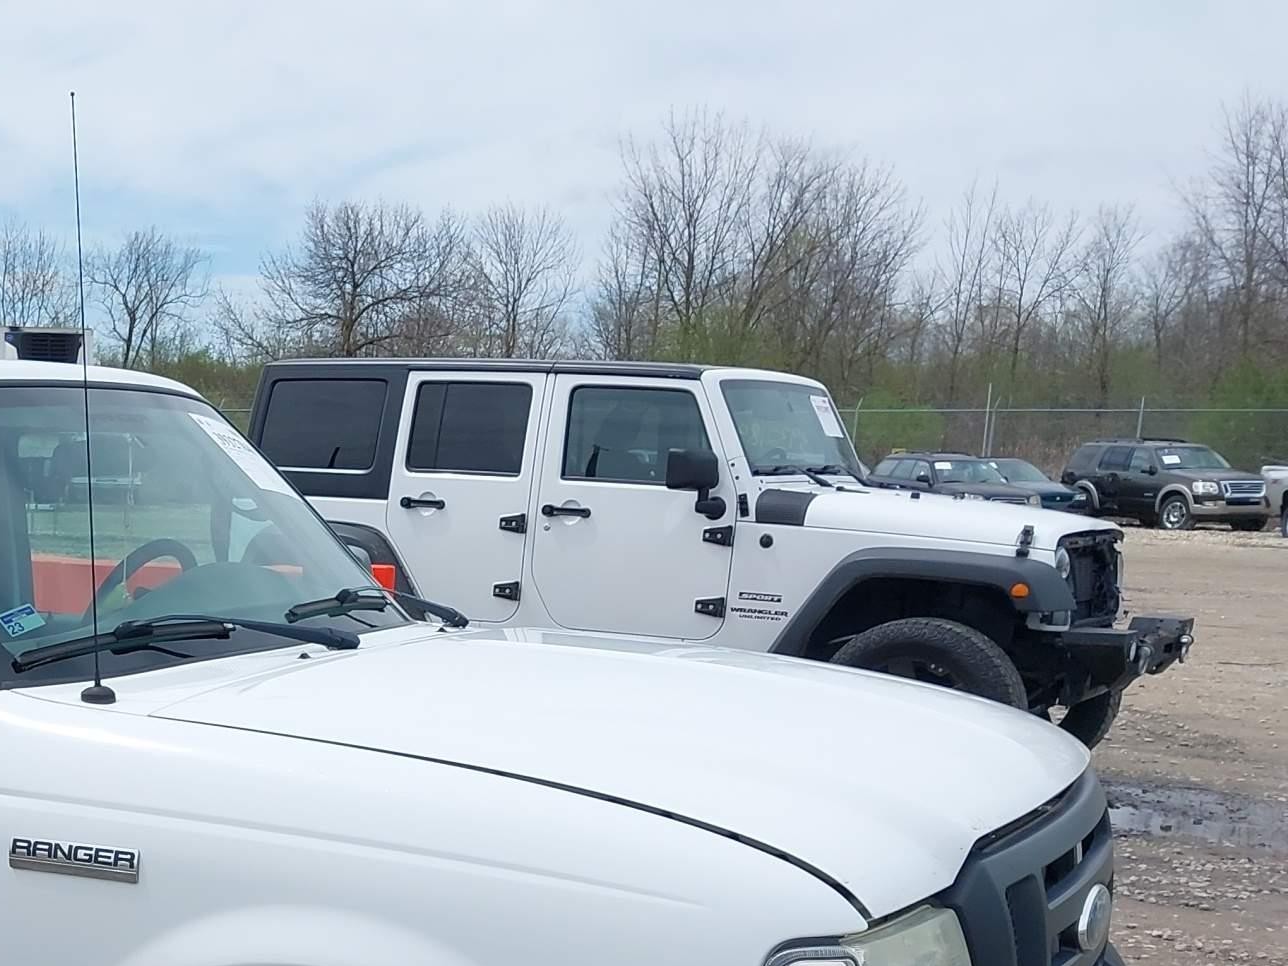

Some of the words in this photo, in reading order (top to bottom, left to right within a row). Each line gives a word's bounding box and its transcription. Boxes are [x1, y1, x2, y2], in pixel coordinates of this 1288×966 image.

[739, 592, 782, 602] SPORT
[730, 607, 789, 617] WRANGLER
[738, 613, 782, 621] UNLIMITED
[7, 622, 25, 635] 23
[11, 838, 136, 869] RANGER
